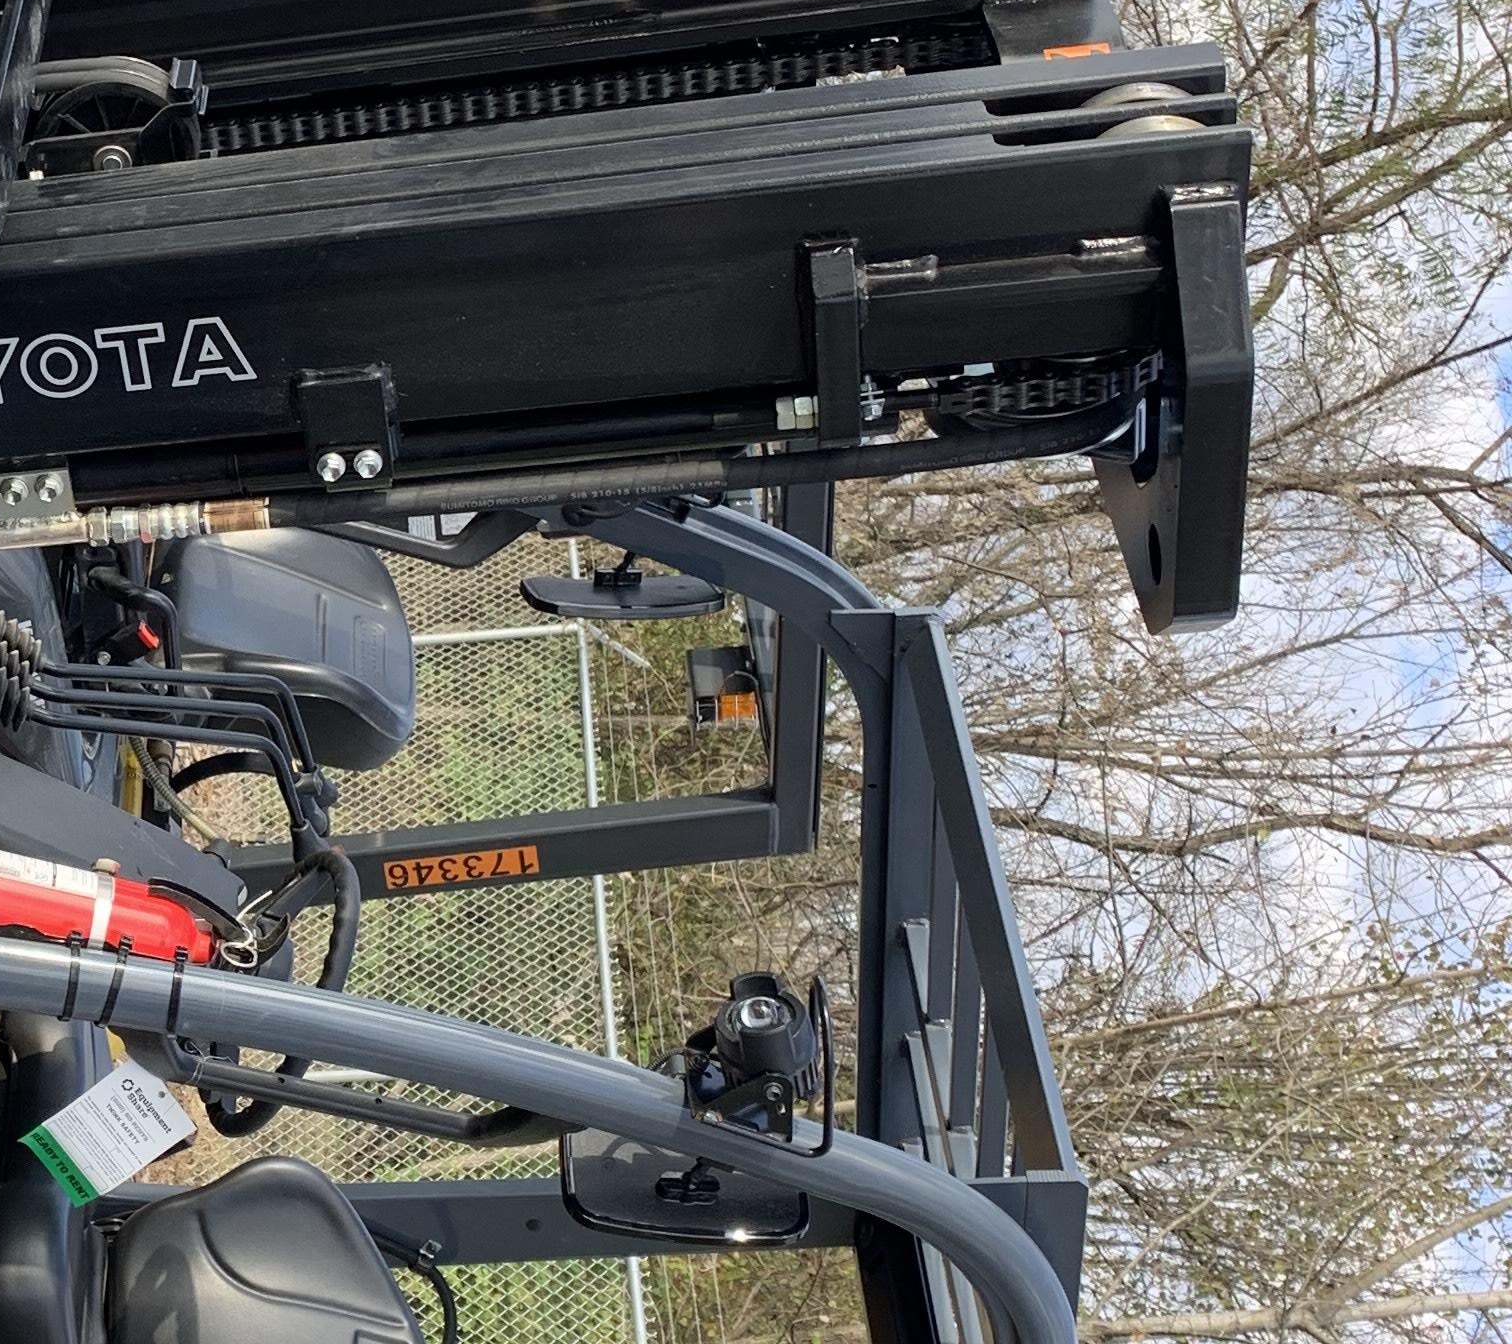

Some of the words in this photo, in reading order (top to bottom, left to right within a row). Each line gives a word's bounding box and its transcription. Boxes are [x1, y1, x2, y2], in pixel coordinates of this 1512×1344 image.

[386, 849, 534, 887] 173346
[127, 1093, 148, 1119] Share
[134, 1088, 172, 1134] Equipment
[119, 1123, 140, 1145] SAFETY
[31, 1132, 57, 1160] READY
[56, 1162, 69, 1174] TO
[65, 1175, 90, 1200] RENT
